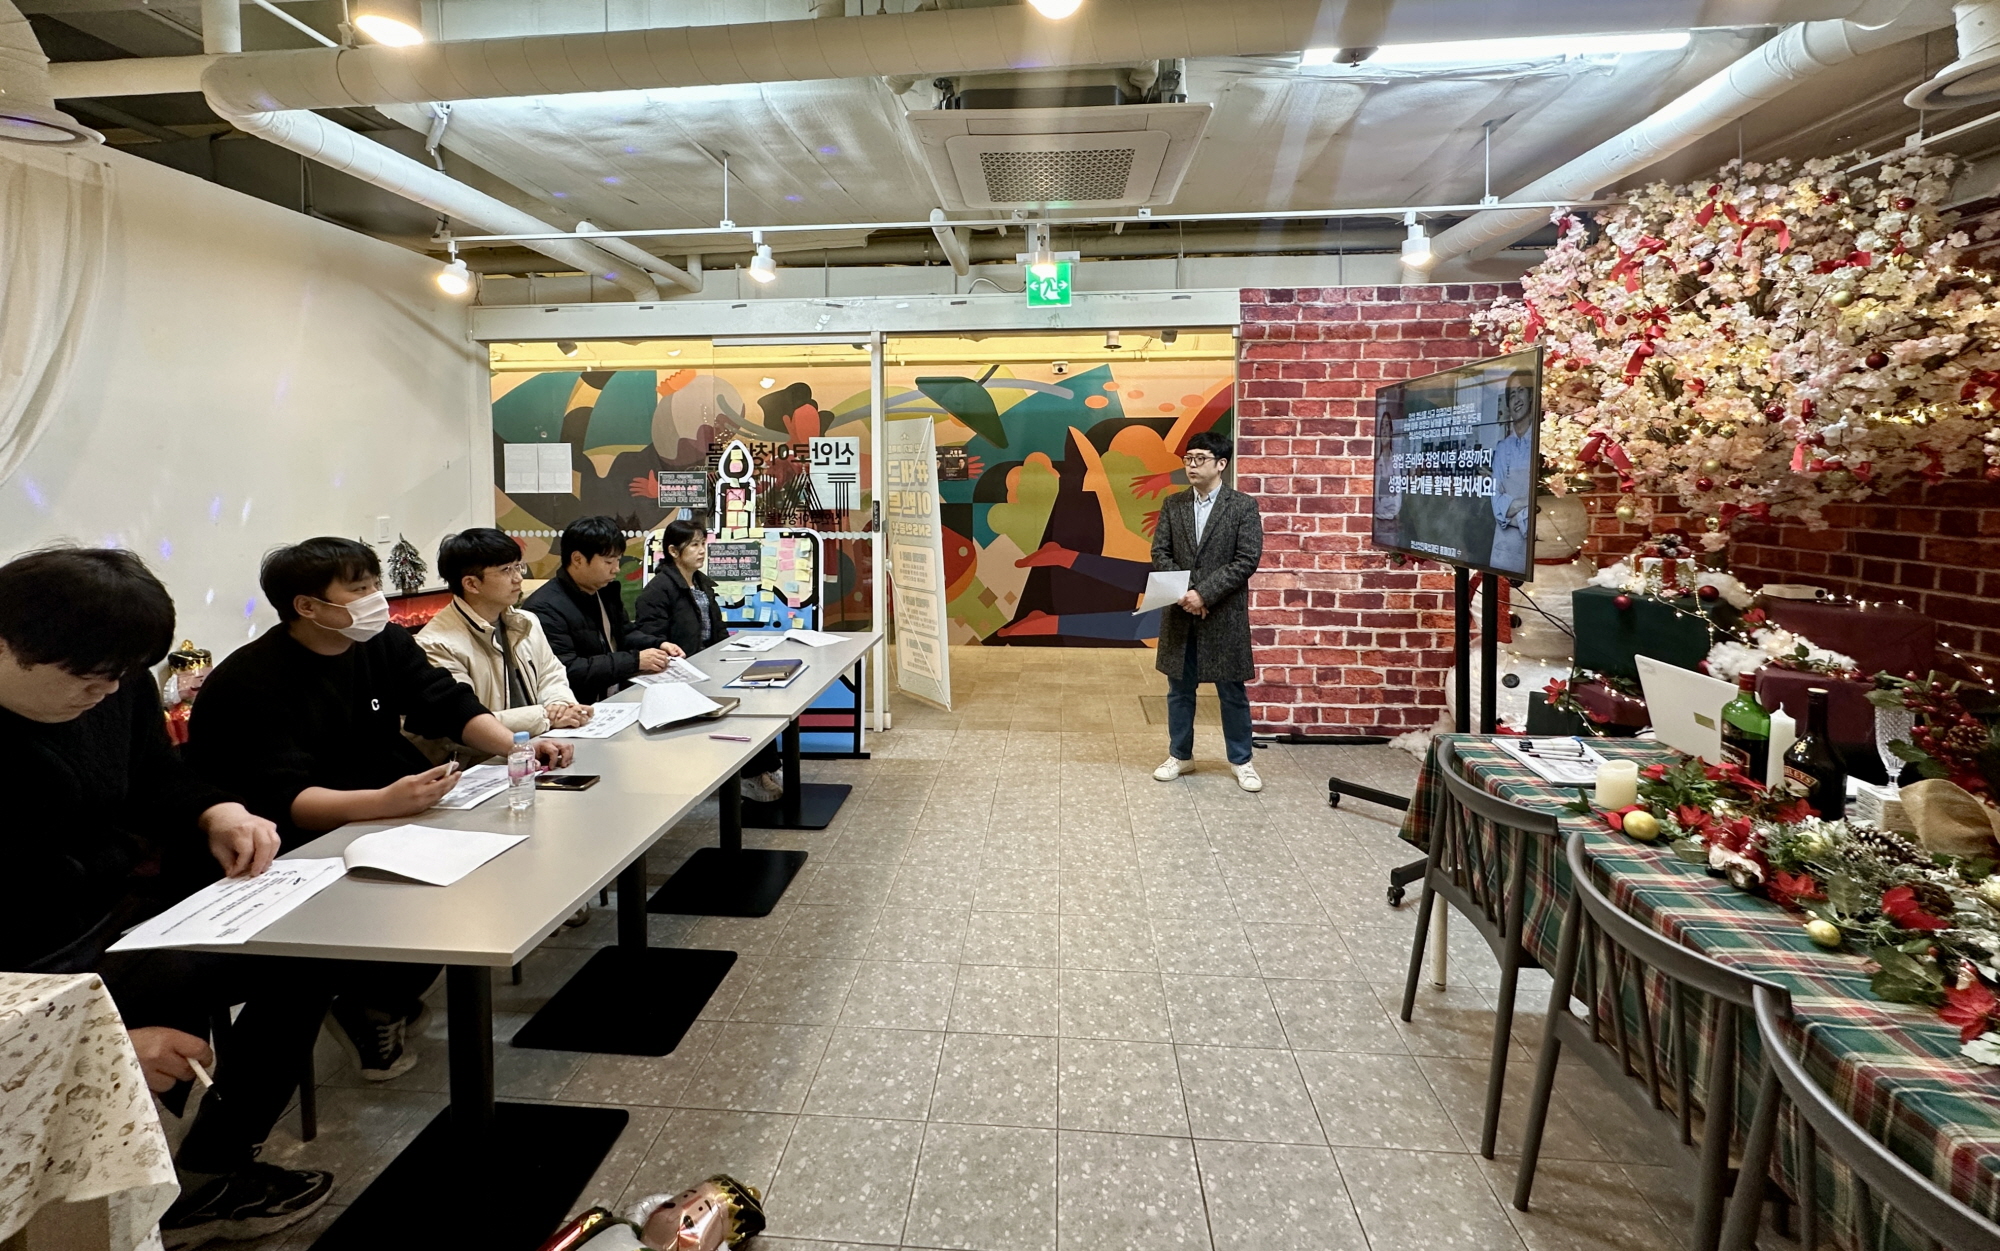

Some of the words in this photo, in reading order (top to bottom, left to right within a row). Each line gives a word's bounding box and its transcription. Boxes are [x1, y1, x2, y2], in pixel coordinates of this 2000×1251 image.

[1392, 453, 1404, 469] 창업
[1405, 452, 1425, 469] 준비와
[1425, 451, 1440, 469] 창업
[1441, 450, 1456, 468] 이후
[1458, 448, 1492, 468] 성장까지
[1388, 475, 1409, 494] 성장의
[1410, 475, 1433, 495] 날개를
[1434, 475, 1452, 497] 활짝
[1453, 475, 1497, 498] 펼치세요!
[371, 698, 380, 711] C
